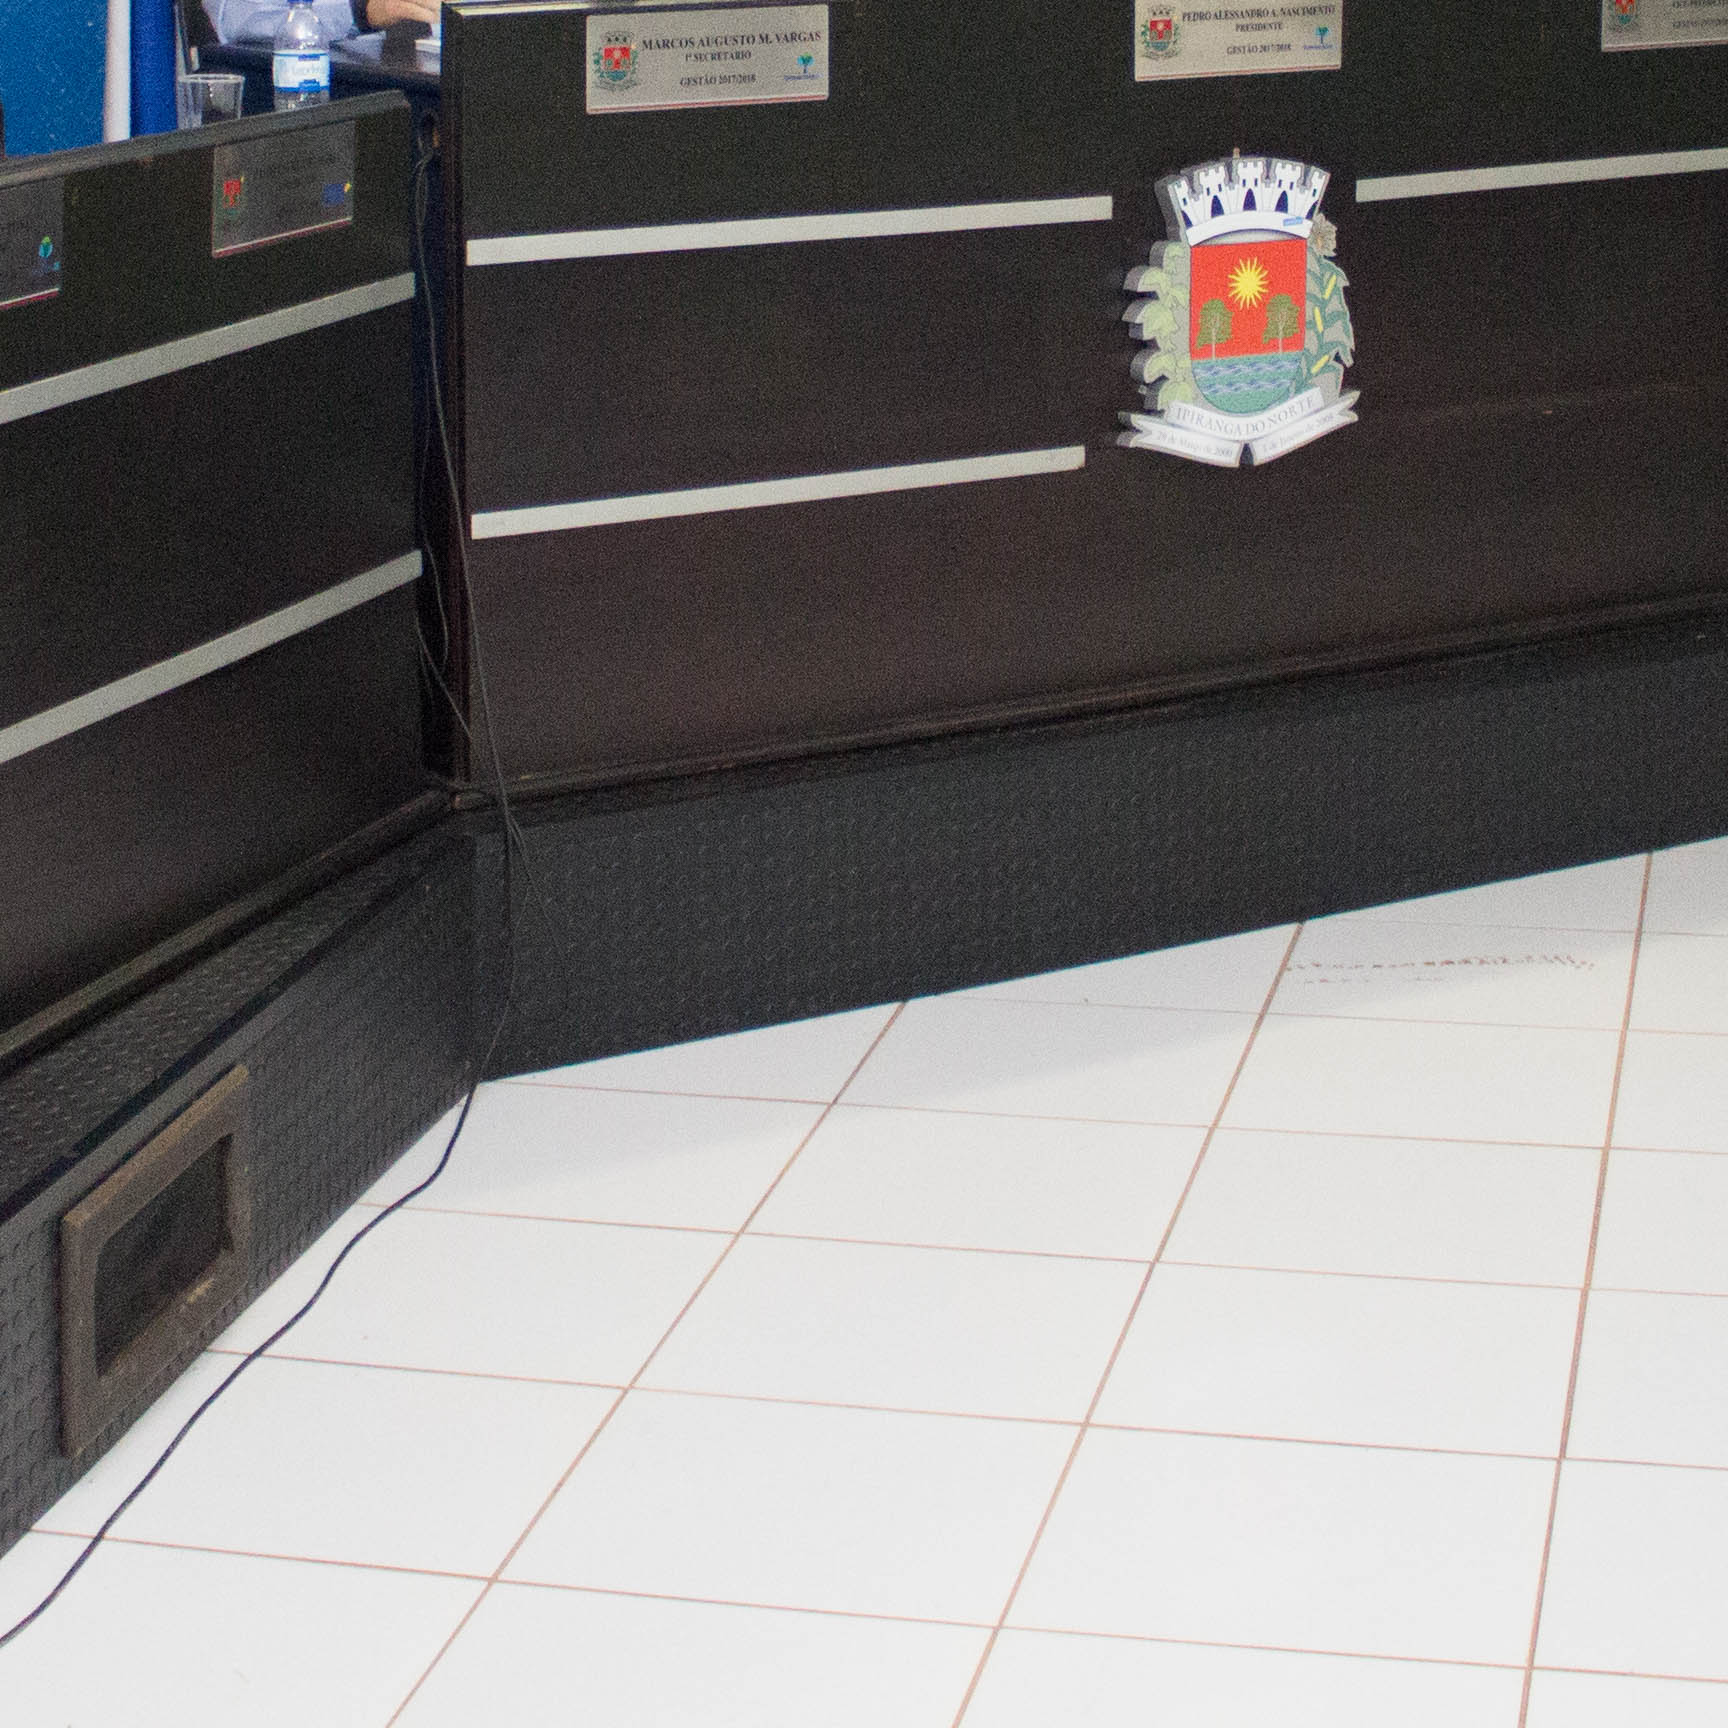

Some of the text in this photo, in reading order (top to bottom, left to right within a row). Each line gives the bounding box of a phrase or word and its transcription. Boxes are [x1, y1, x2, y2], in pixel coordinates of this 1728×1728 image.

[641, 37, 695, 51] MARCOS
[697, 33, 757, 49] AUGUSTO
[774, 31, 822, 44] VARGAS
[679, 74, 717, 87] GESTÃO
[1176, 407, 1242, 436] IPIRANGA
[1245, 421, 1265, 436] DO
[1267, 395, 1314, 425] NORTE
